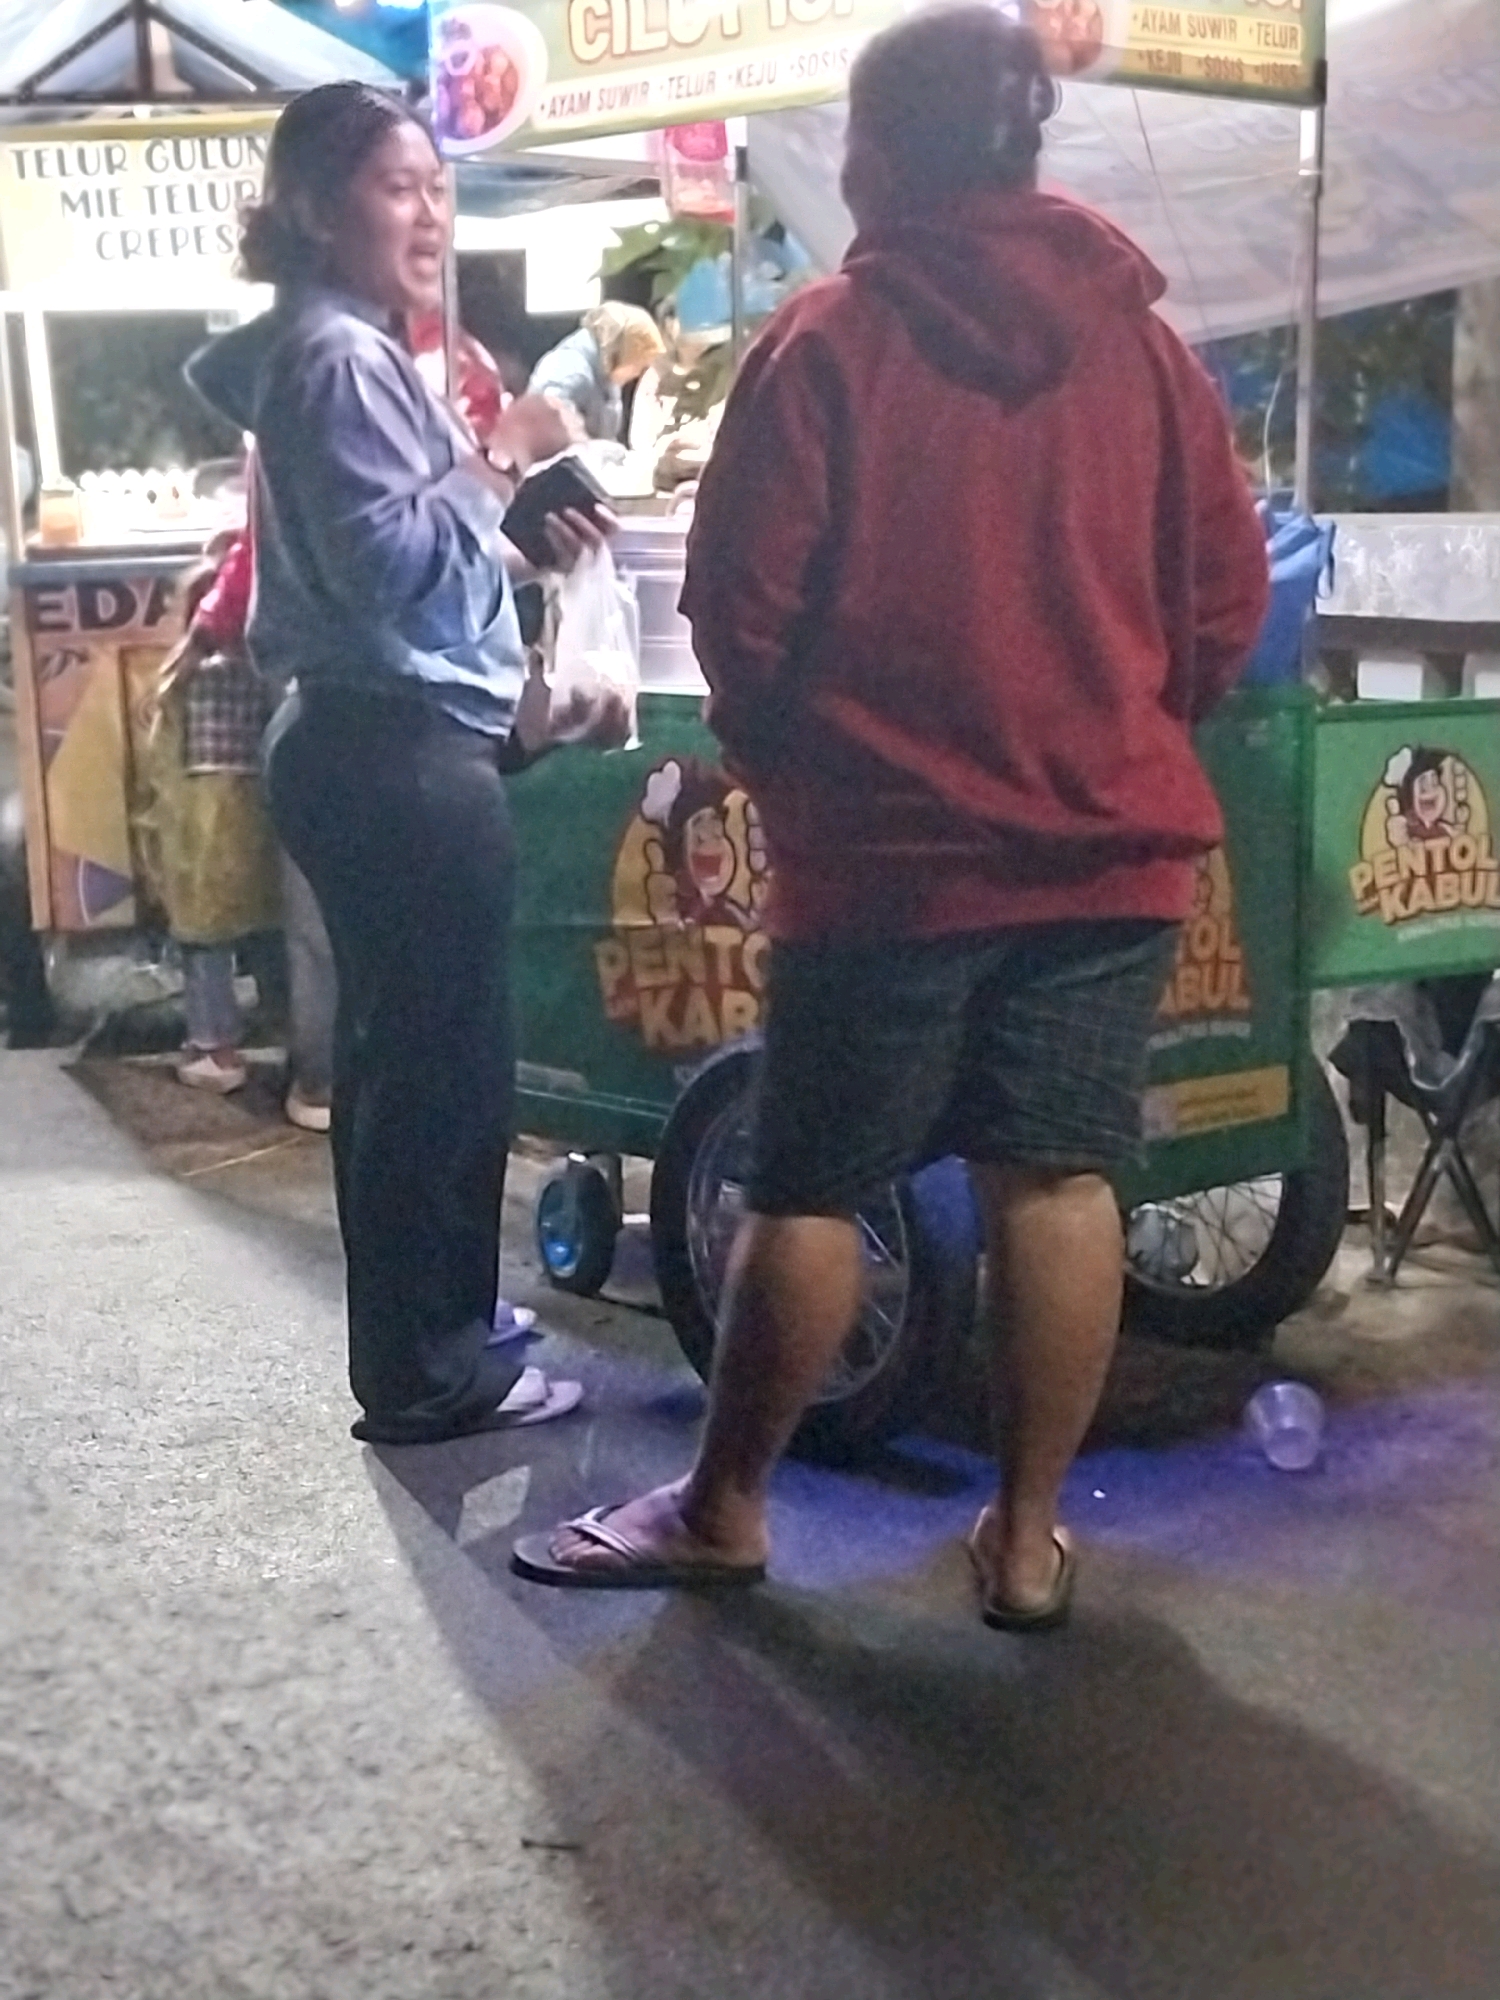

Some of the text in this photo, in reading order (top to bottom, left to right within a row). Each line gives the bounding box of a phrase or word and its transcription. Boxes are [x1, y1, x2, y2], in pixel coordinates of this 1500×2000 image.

[1140, 8, 1300, 51] AYAM SUWIR TELUR
[548, 47, 849, 119] AYAM SUWIR TELUR KEJU SOSIS
[10, 142, 128, 180] TELUR
[60, 178, 263, 219] MIE TELUR
[96, 223, 235, 261] CREPES
[1349, 834, 1499, 904] PENTOL
[1380, 871, 1500, 923] KABUL
